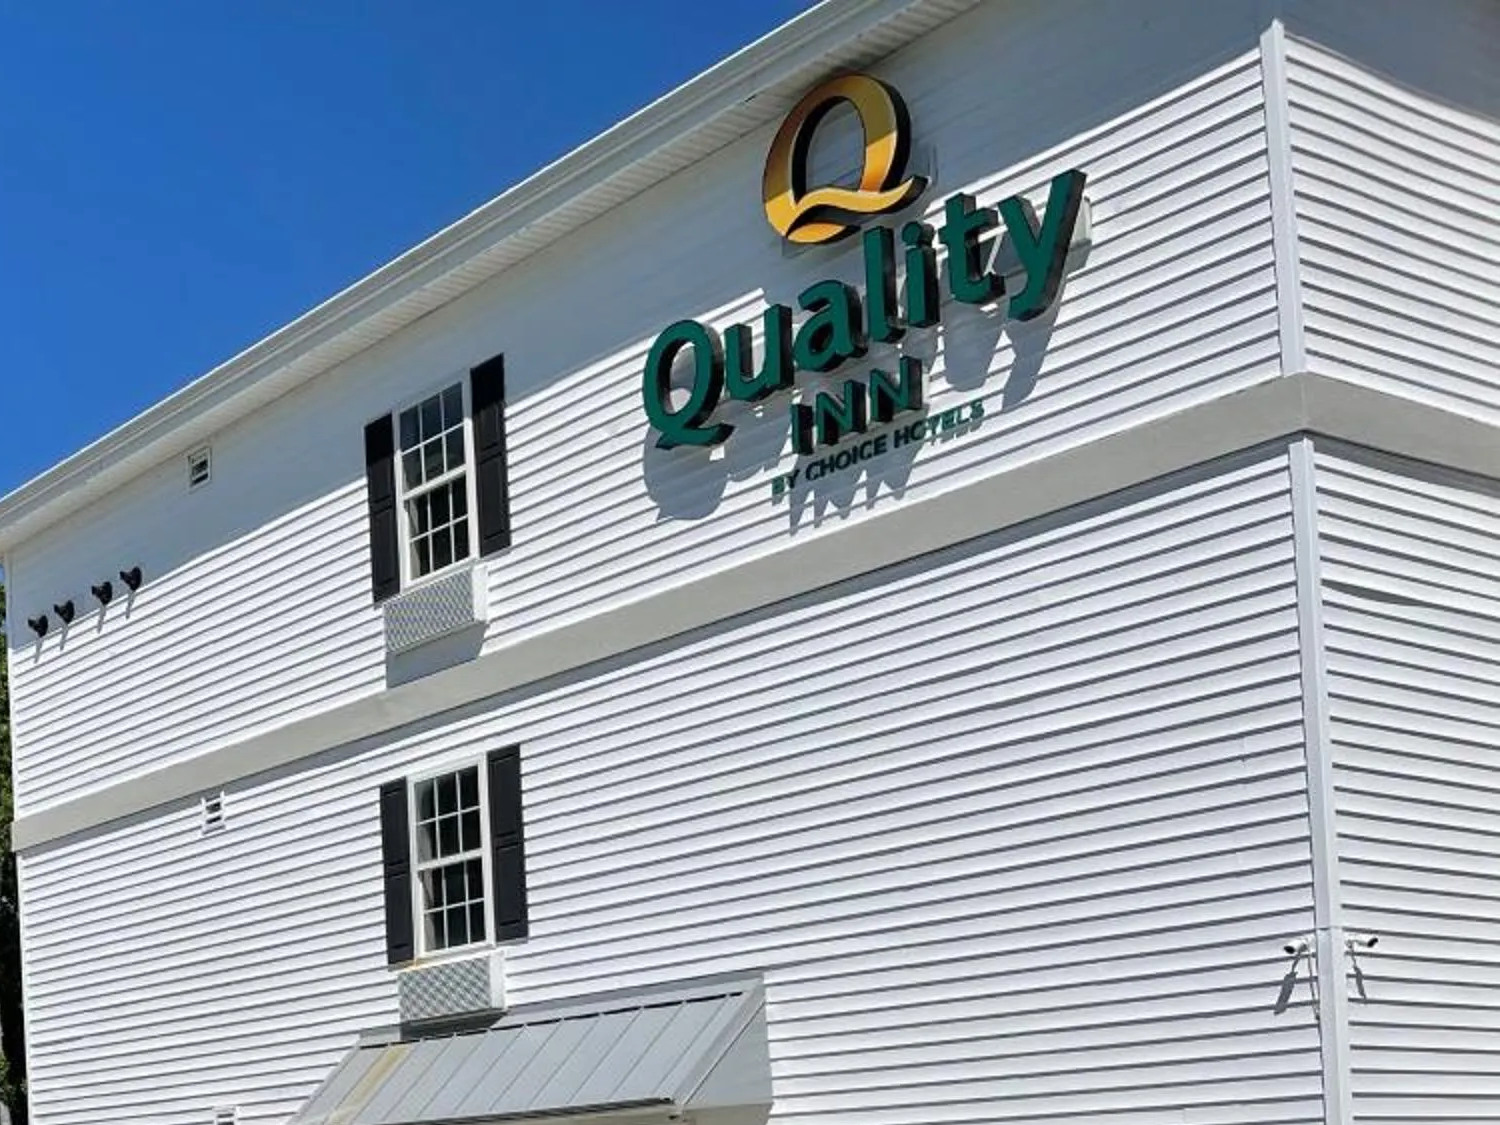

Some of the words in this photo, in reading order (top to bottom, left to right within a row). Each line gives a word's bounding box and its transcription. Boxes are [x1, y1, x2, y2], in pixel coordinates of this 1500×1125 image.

[642, 168, 1088, 450] Quality
[771, 469, 800, 496] BY
[804, 433, 888, 482] CHOICE
[893, 399, 986, 450] HOTELS
[791, 356, 924, 456] INN
